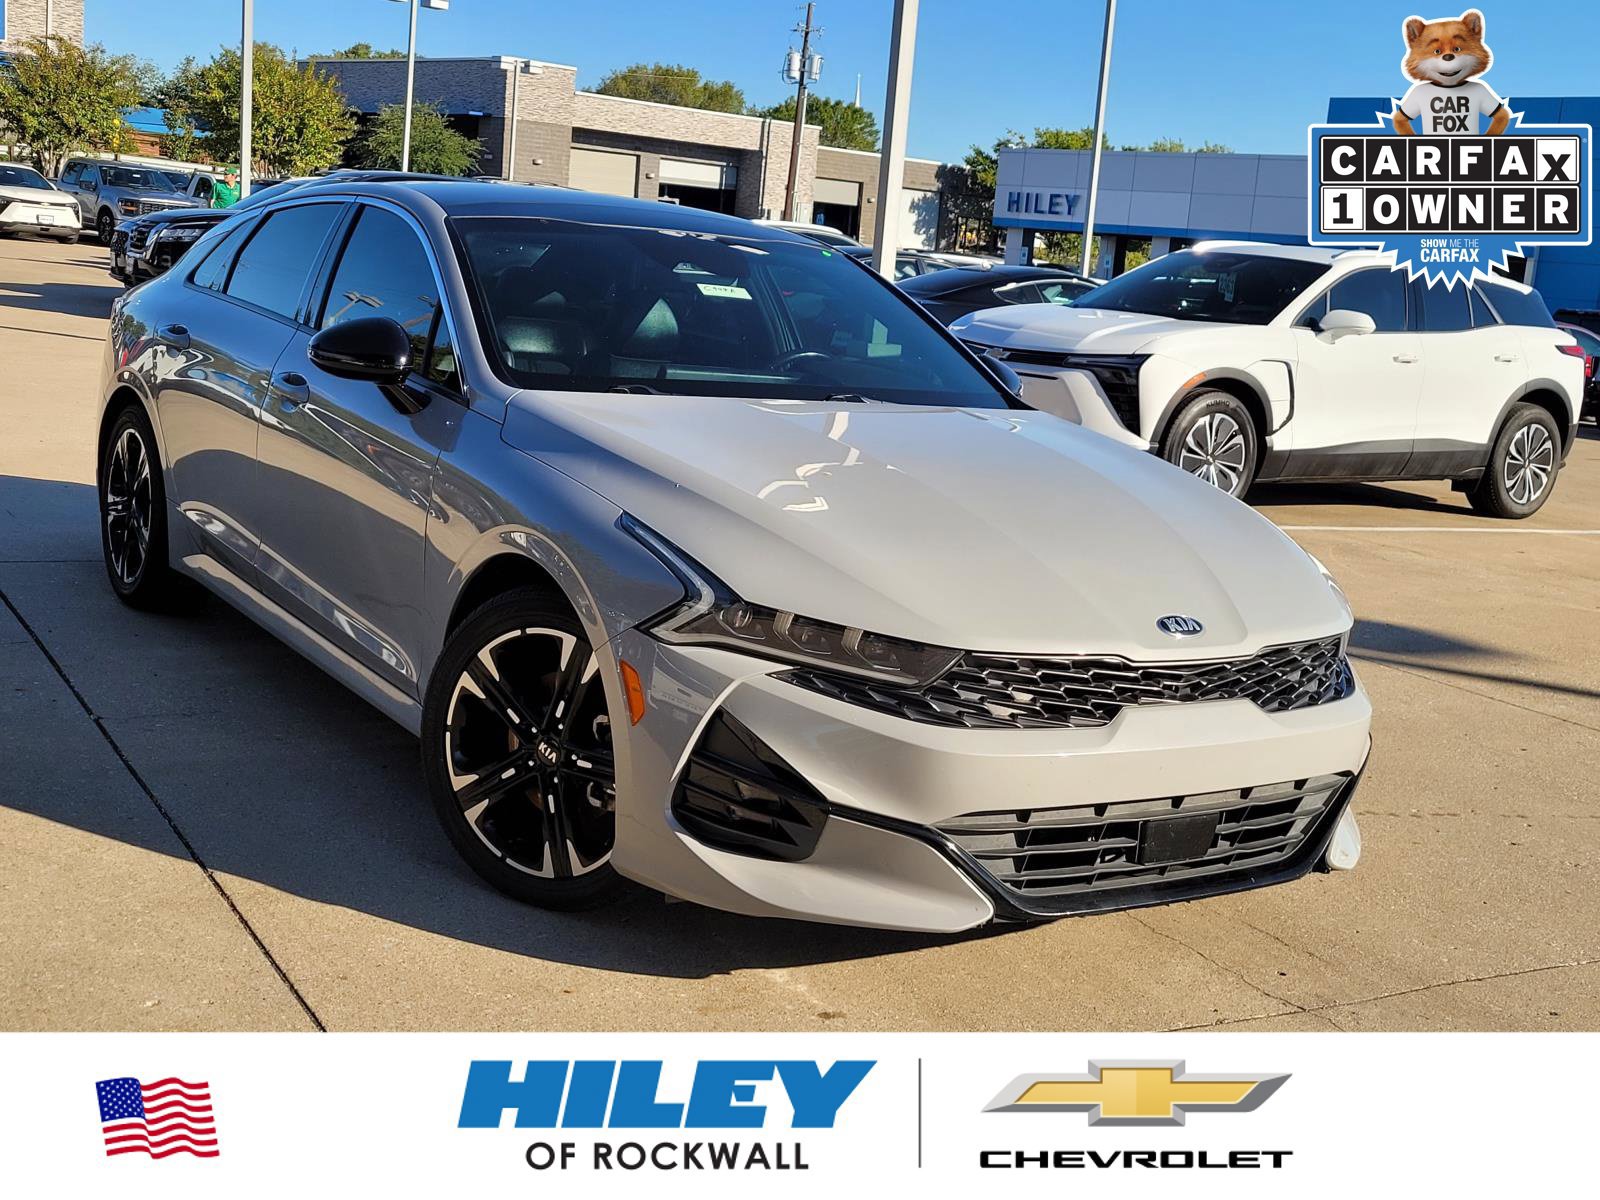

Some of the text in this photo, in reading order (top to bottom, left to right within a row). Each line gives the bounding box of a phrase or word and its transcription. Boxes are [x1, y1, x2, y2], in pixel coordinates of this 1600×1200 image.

[1007, 191, 1081, 216] HILEY
[1163, 617, 1201, 631] KIA
[538, 741, 557, 763] KIA
